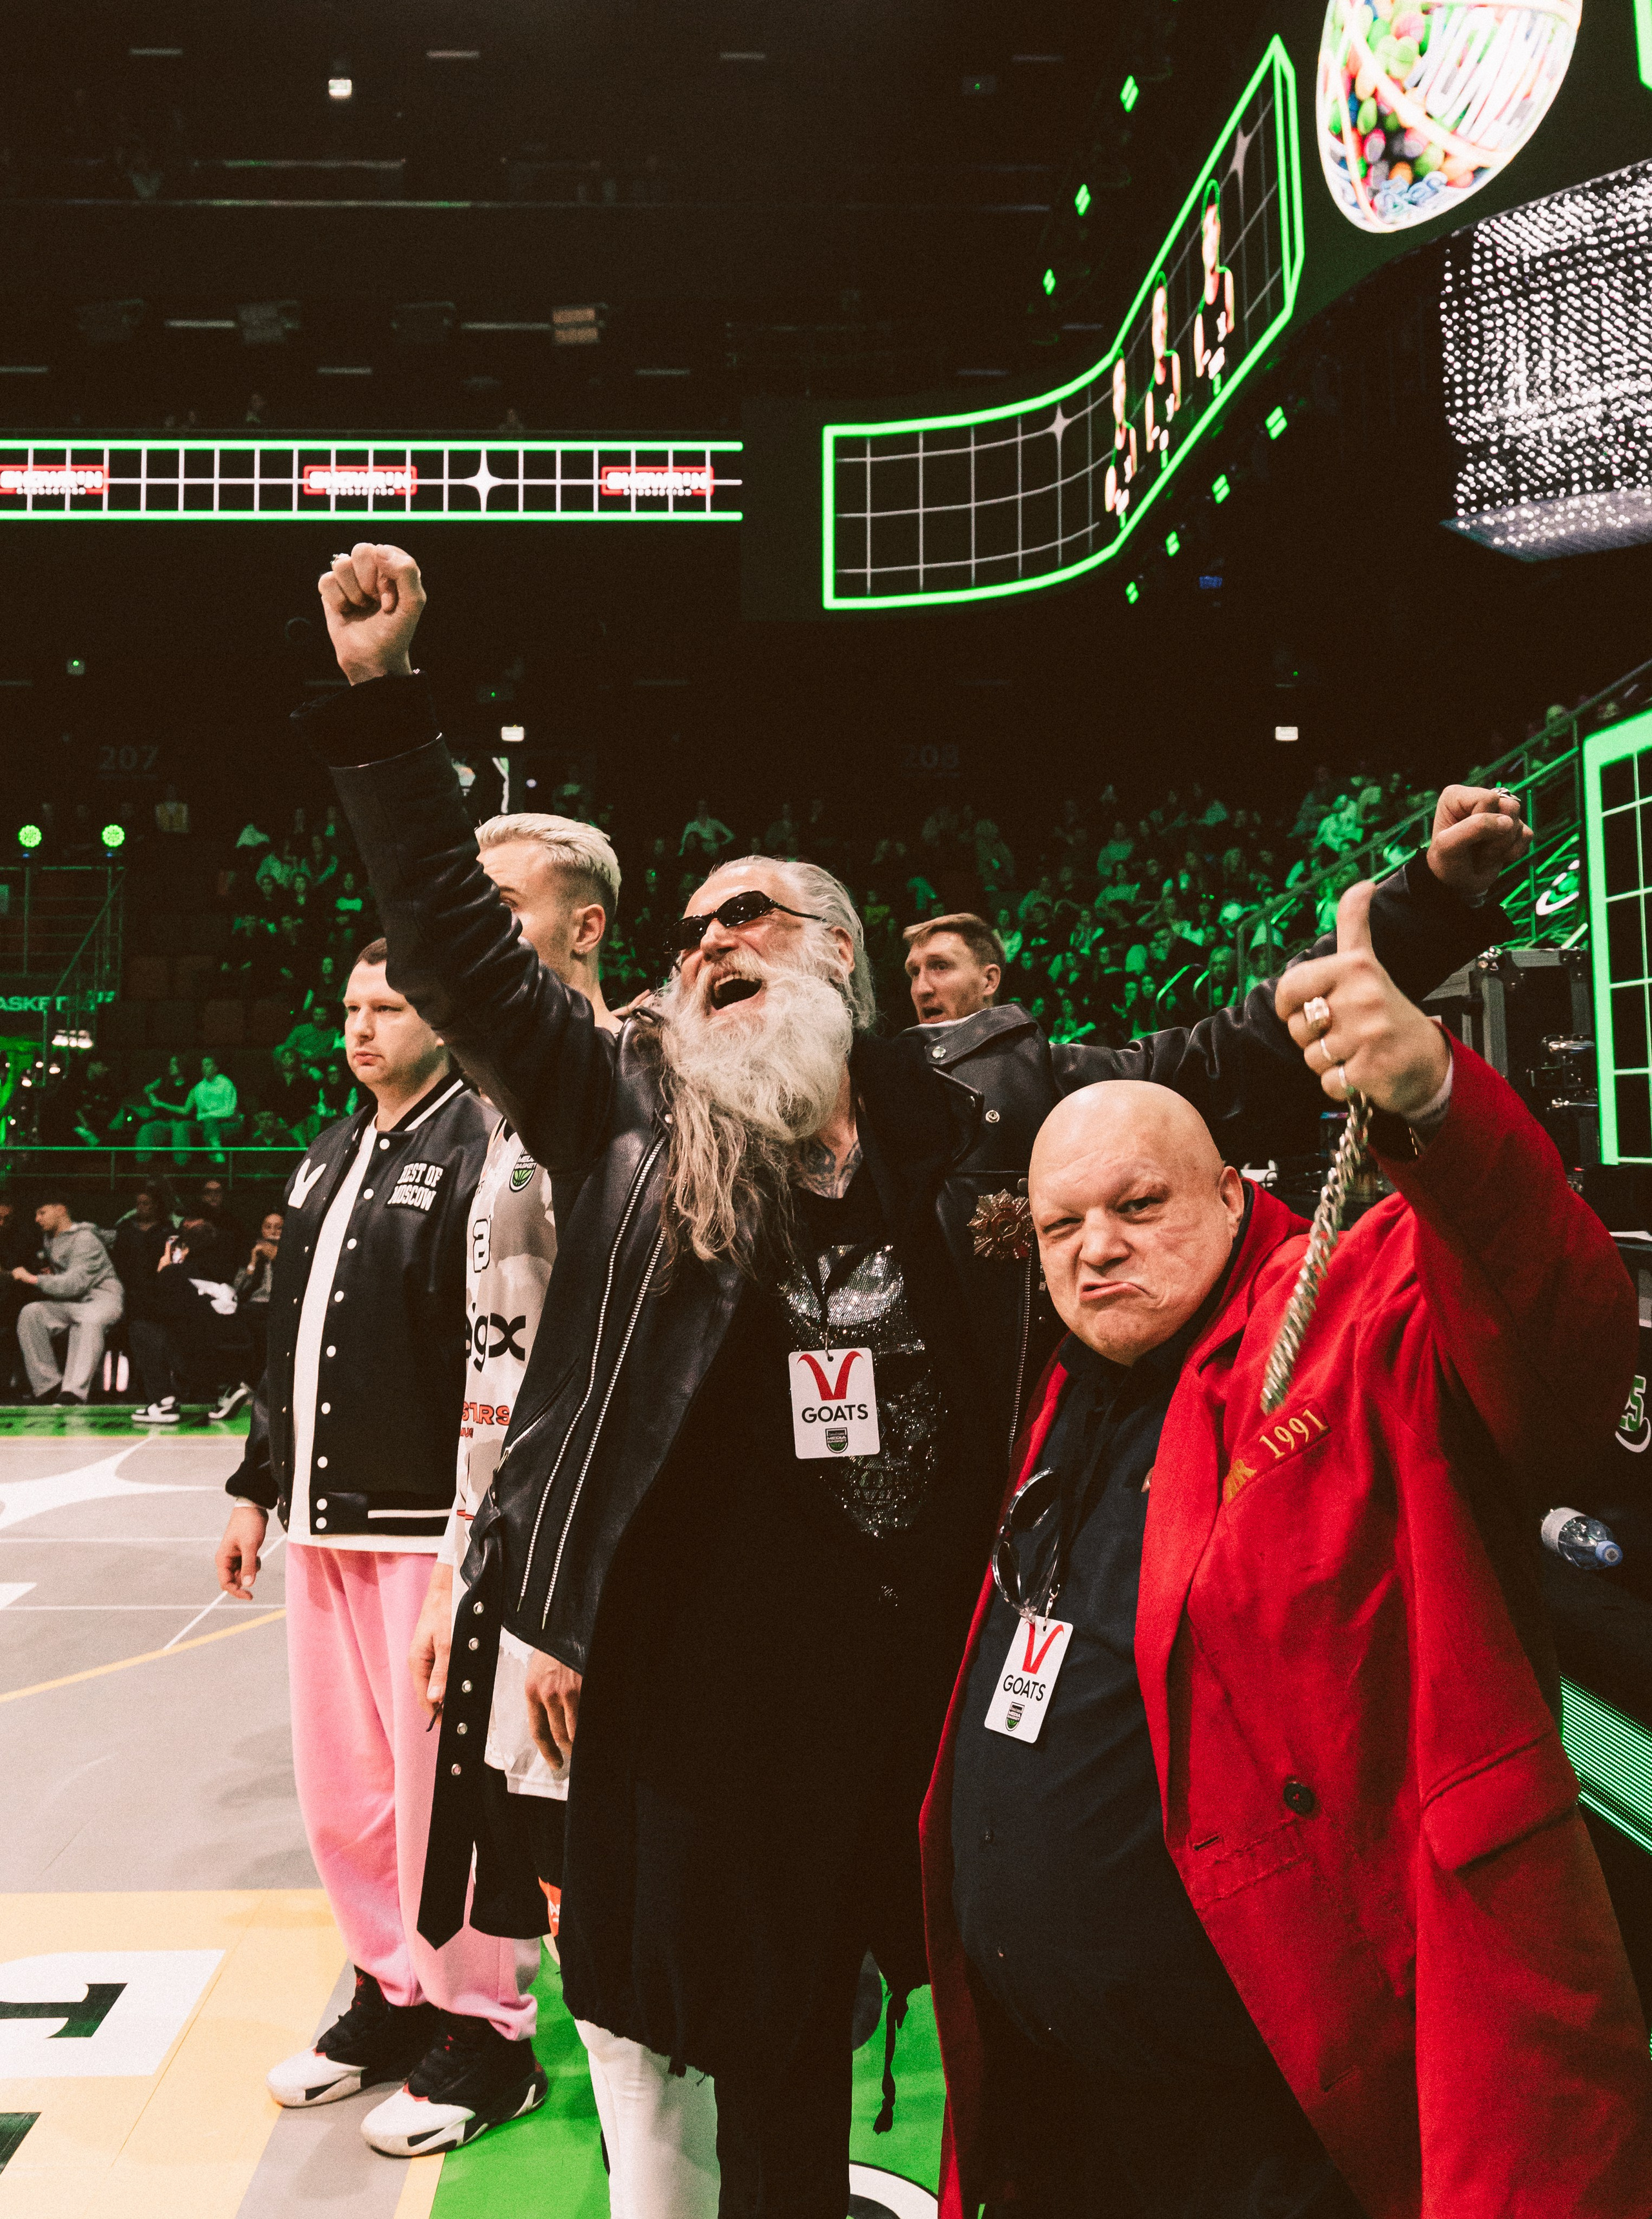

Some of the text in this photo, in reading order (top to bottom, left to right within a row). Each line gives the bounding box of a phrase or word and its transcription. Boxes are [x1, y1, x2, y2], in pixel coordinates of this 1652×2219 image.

[99, 744, 159, 770] 207
[397, 1163, 444, 1187] BEST OF
[387, 1184, 437, 1211] MOSCOW
[801, 1403, 868, 1423] GOATS
[1259, 1409, 1328, 1459] 1991
[1003, 1674, 1046, 1702] GOATS
